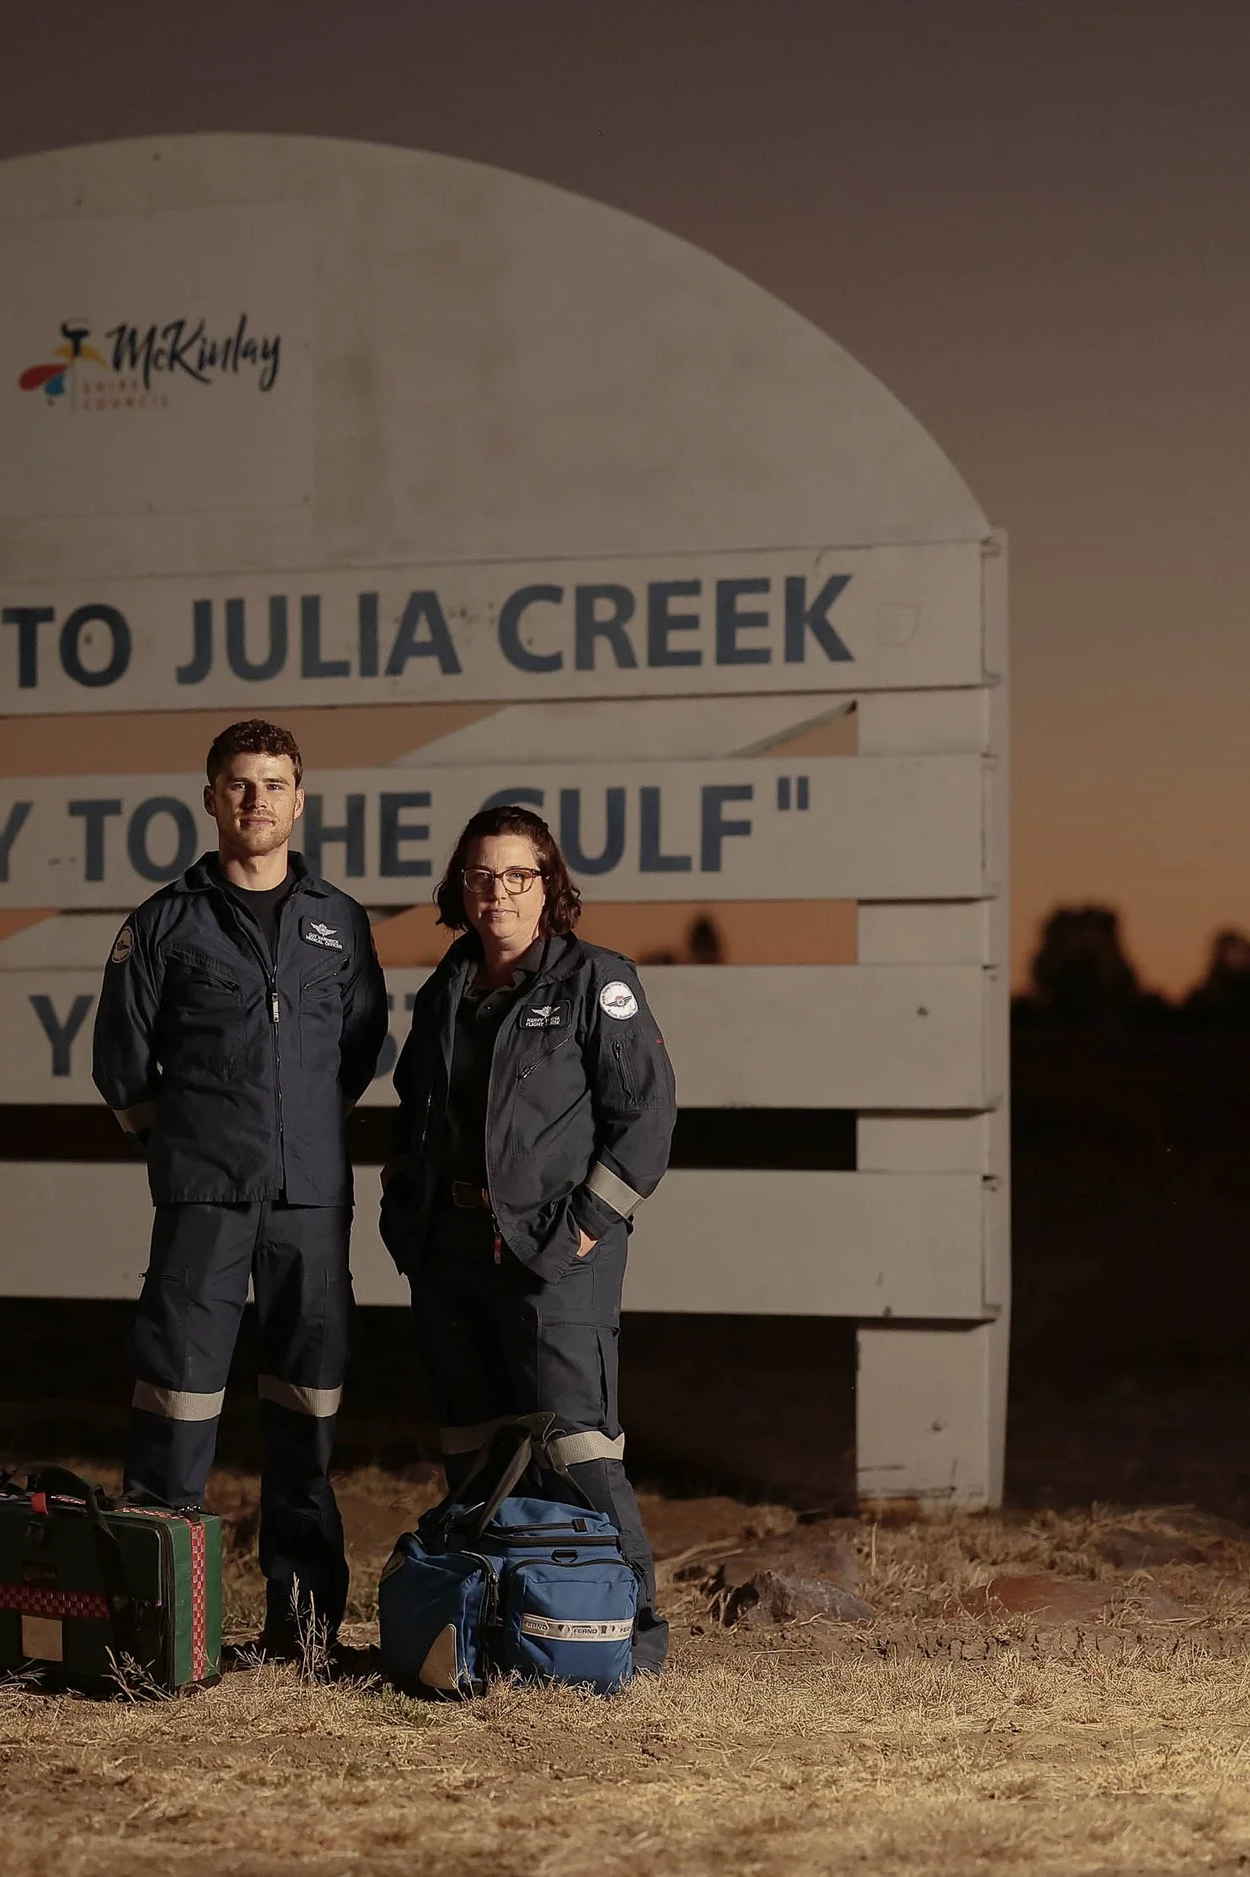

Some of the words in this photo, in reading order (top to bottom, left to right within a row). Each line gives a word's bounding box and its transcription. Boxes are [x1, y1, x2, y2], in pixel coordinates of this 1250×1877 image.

[105, 312, 281, 392] McKinlay
[1, 603, 132, 689] TO
[176, 590, 462, 685] JULIA
[498, 574, 856, 673] CREEK
[69, 796, 197, 883] TO
[304, 791, 432, 877] HE
